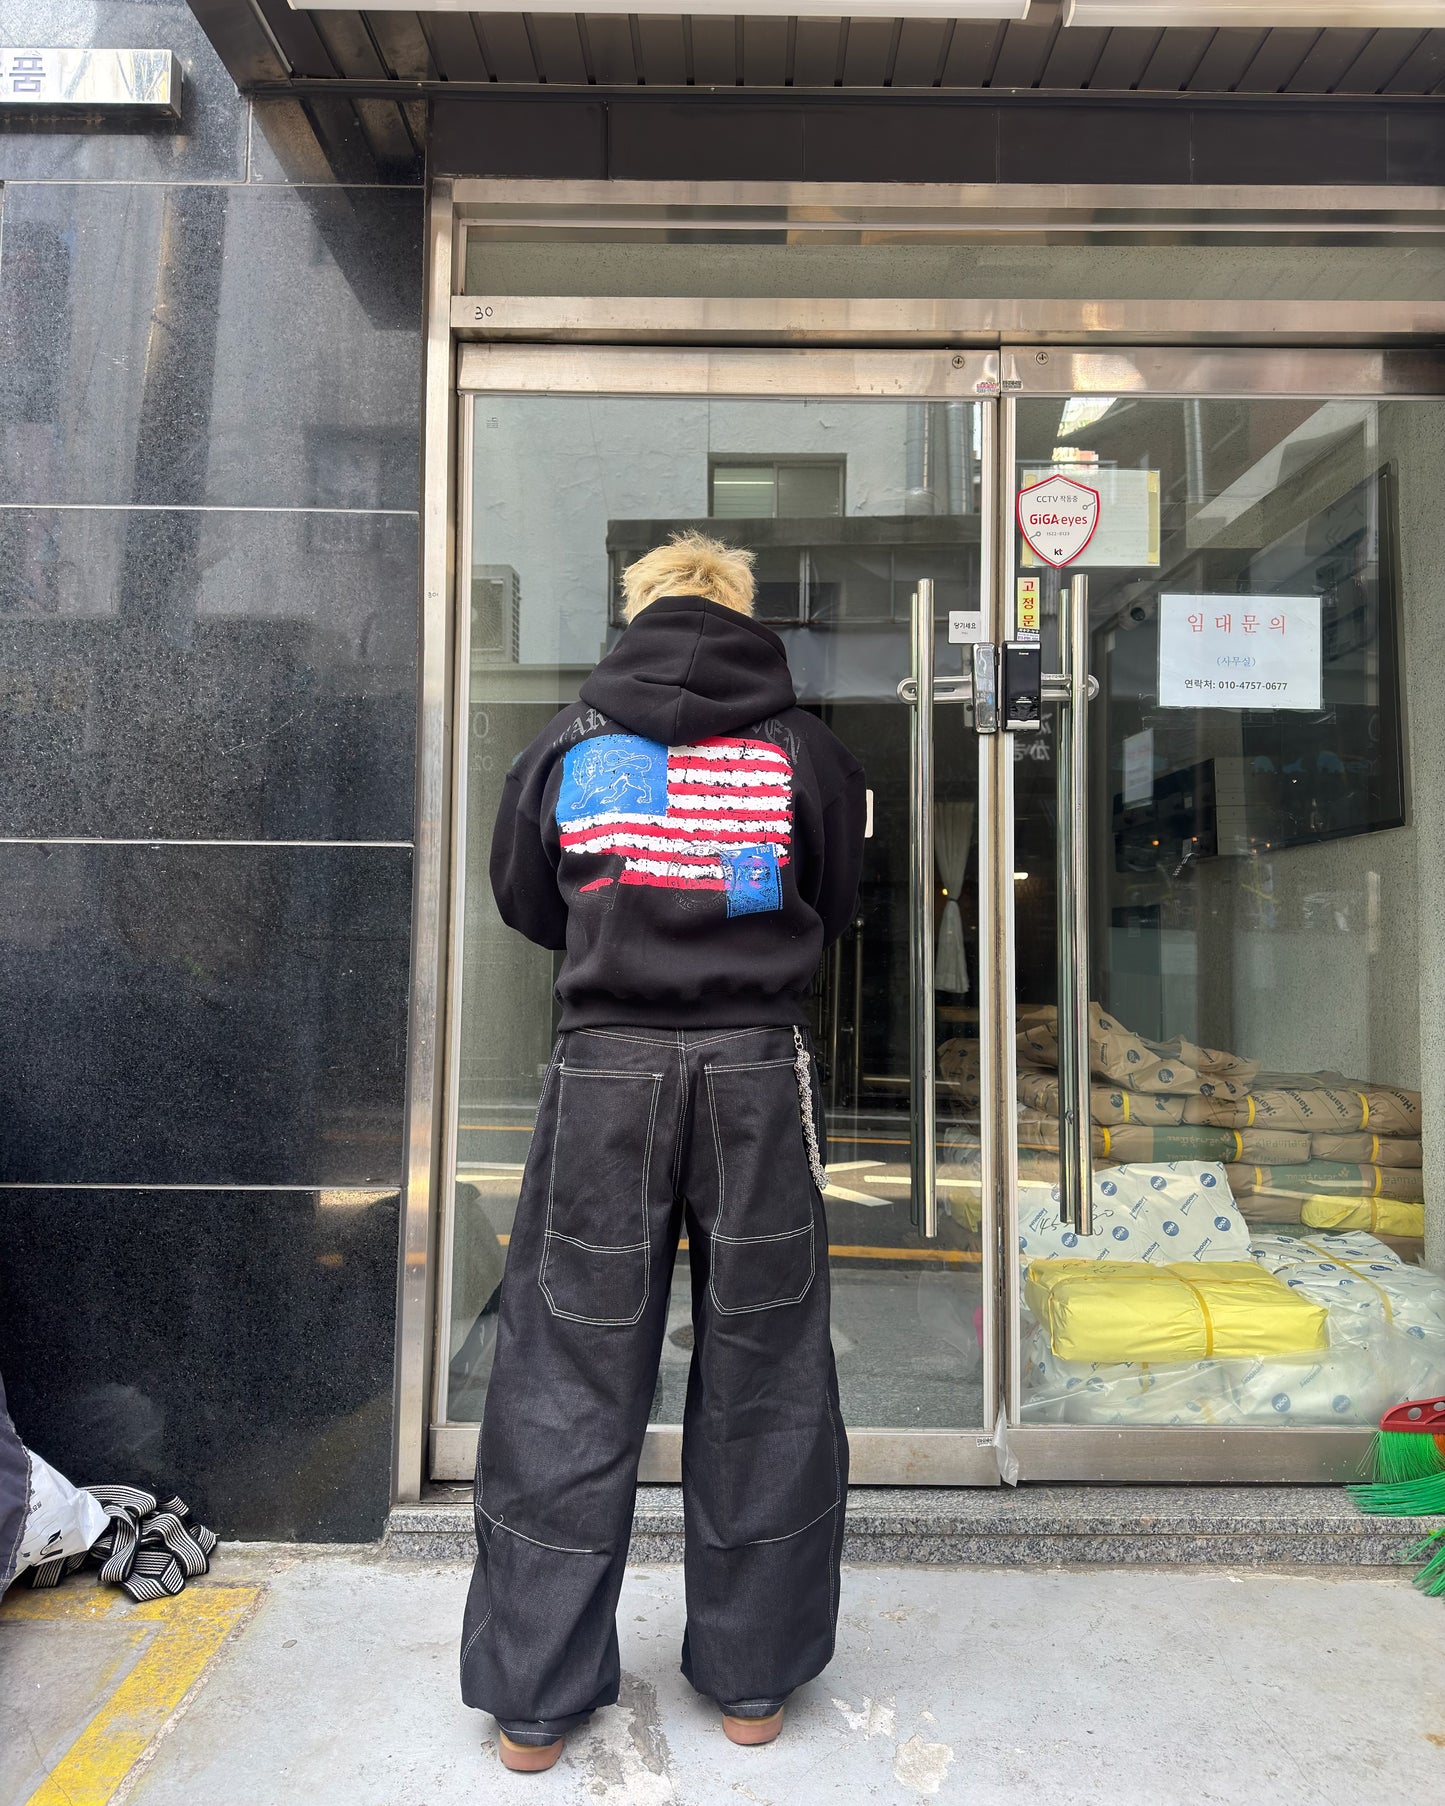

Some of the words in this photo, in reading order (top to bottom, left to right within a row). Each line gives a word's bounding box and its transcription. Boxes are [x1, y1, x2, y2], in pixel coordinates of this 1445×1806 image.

[0, 57, 46, 93] 품
[475, 306, 494, 320] 30
[1036, 495, 1059, 503] CCTV
[1060, 495, 1078, 503] 작동중
[1029, 513, 1060, 525] GiGA
[1054, 548, 1063, 556] kt
[953, 622, 977, 630] 당기세요
[1216, 656, 1256, 668] (사무실)
[1184, 679, 1216, 689] 연락처:
[1218, 680, 1288, 691] 010-4757-0677
